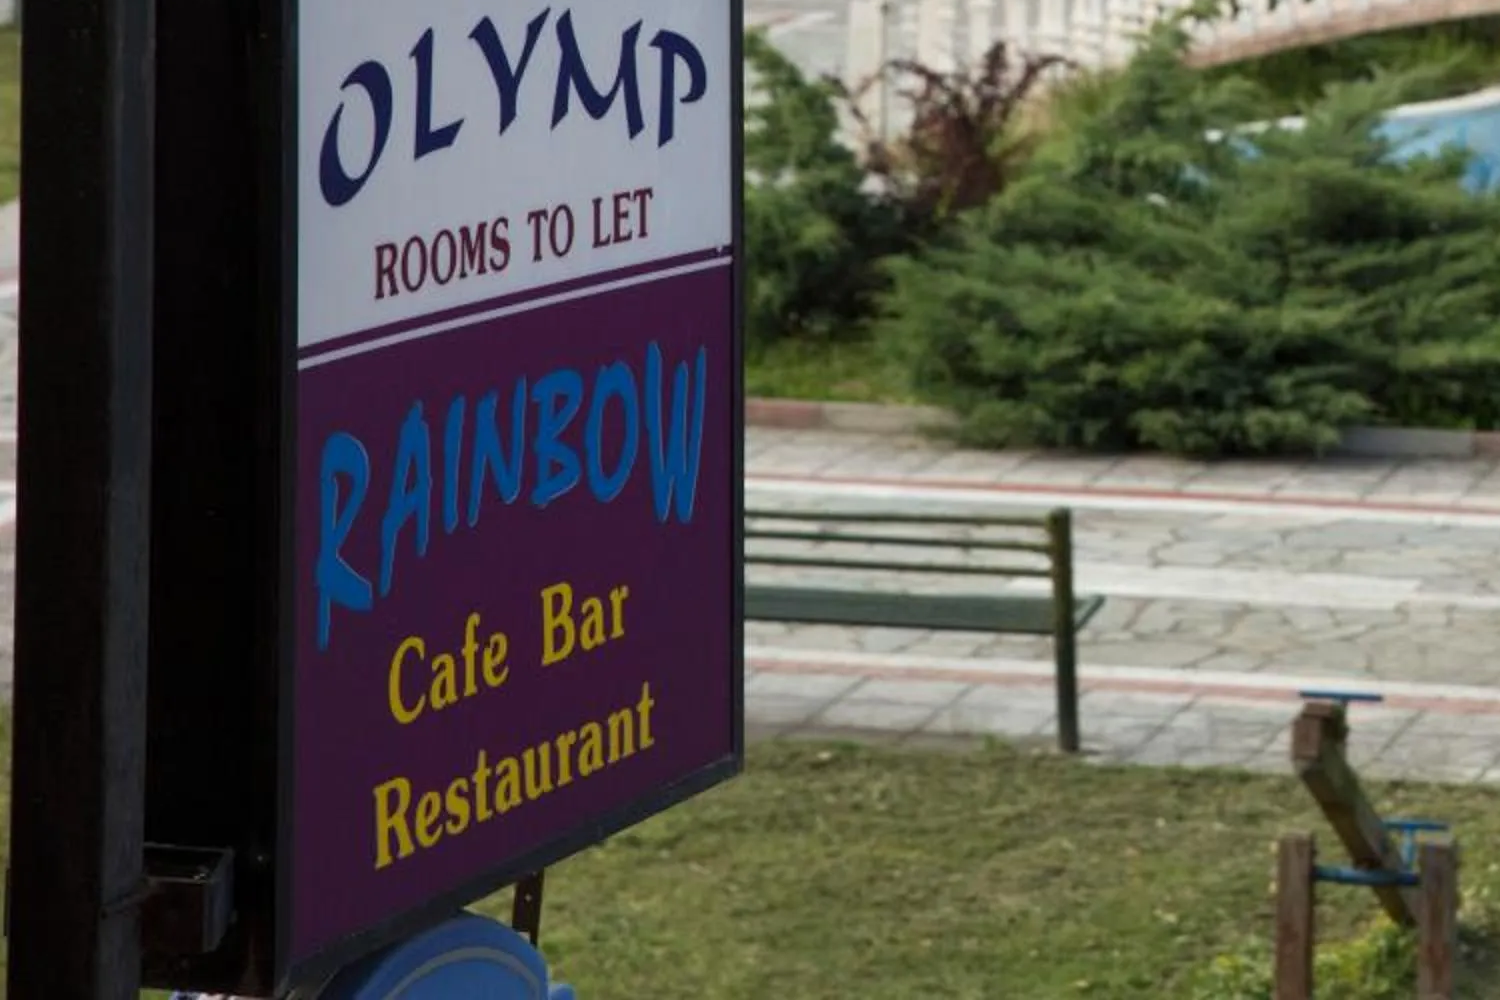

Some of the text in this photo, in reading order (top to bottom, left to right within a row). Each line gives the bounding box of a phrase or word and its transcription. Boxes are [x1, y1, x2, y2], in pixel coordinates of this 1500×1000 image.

[319, 7, 707, 207] OLYMP
[374, 187, 653, 300] ROOMS TO LET
[317, 341, 706, 651] RAINBOW
[388, 582, 629, 724] Cafe Bar
[373, 681, 655, 870] Restaurant
